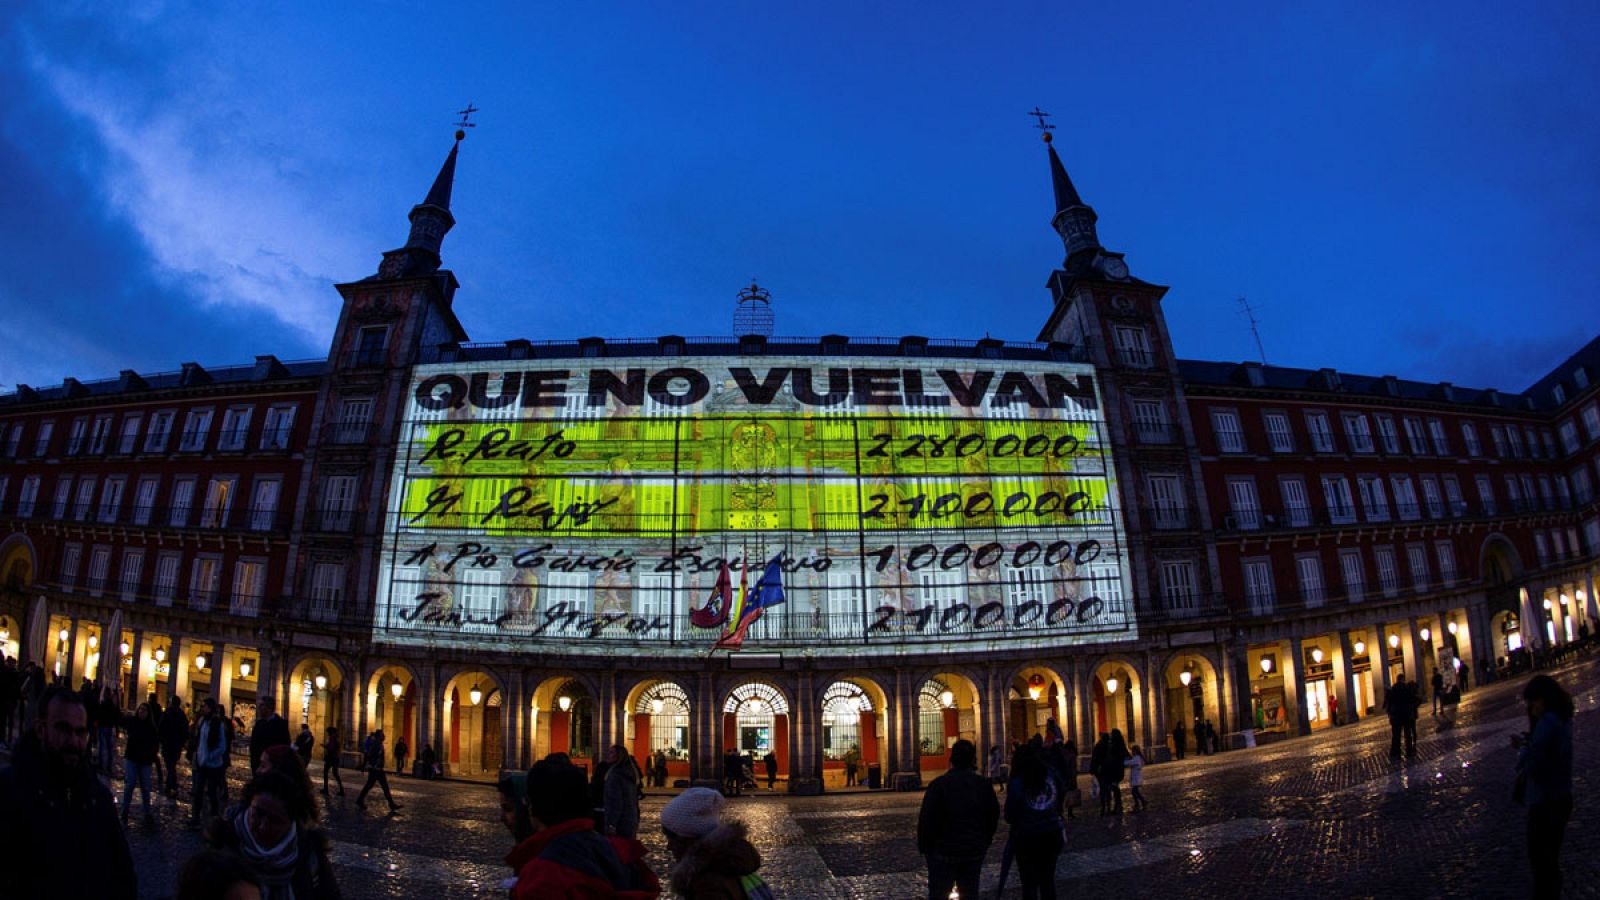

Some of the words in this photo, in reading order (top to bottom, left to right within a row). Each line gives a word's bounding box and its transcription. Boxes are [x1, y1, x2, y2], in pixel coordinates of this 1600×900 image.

[415, 370, 570, 409] QUE
[588, 367, 710, 406] NO
[728, 367, 1098, 409] VUELVAN
